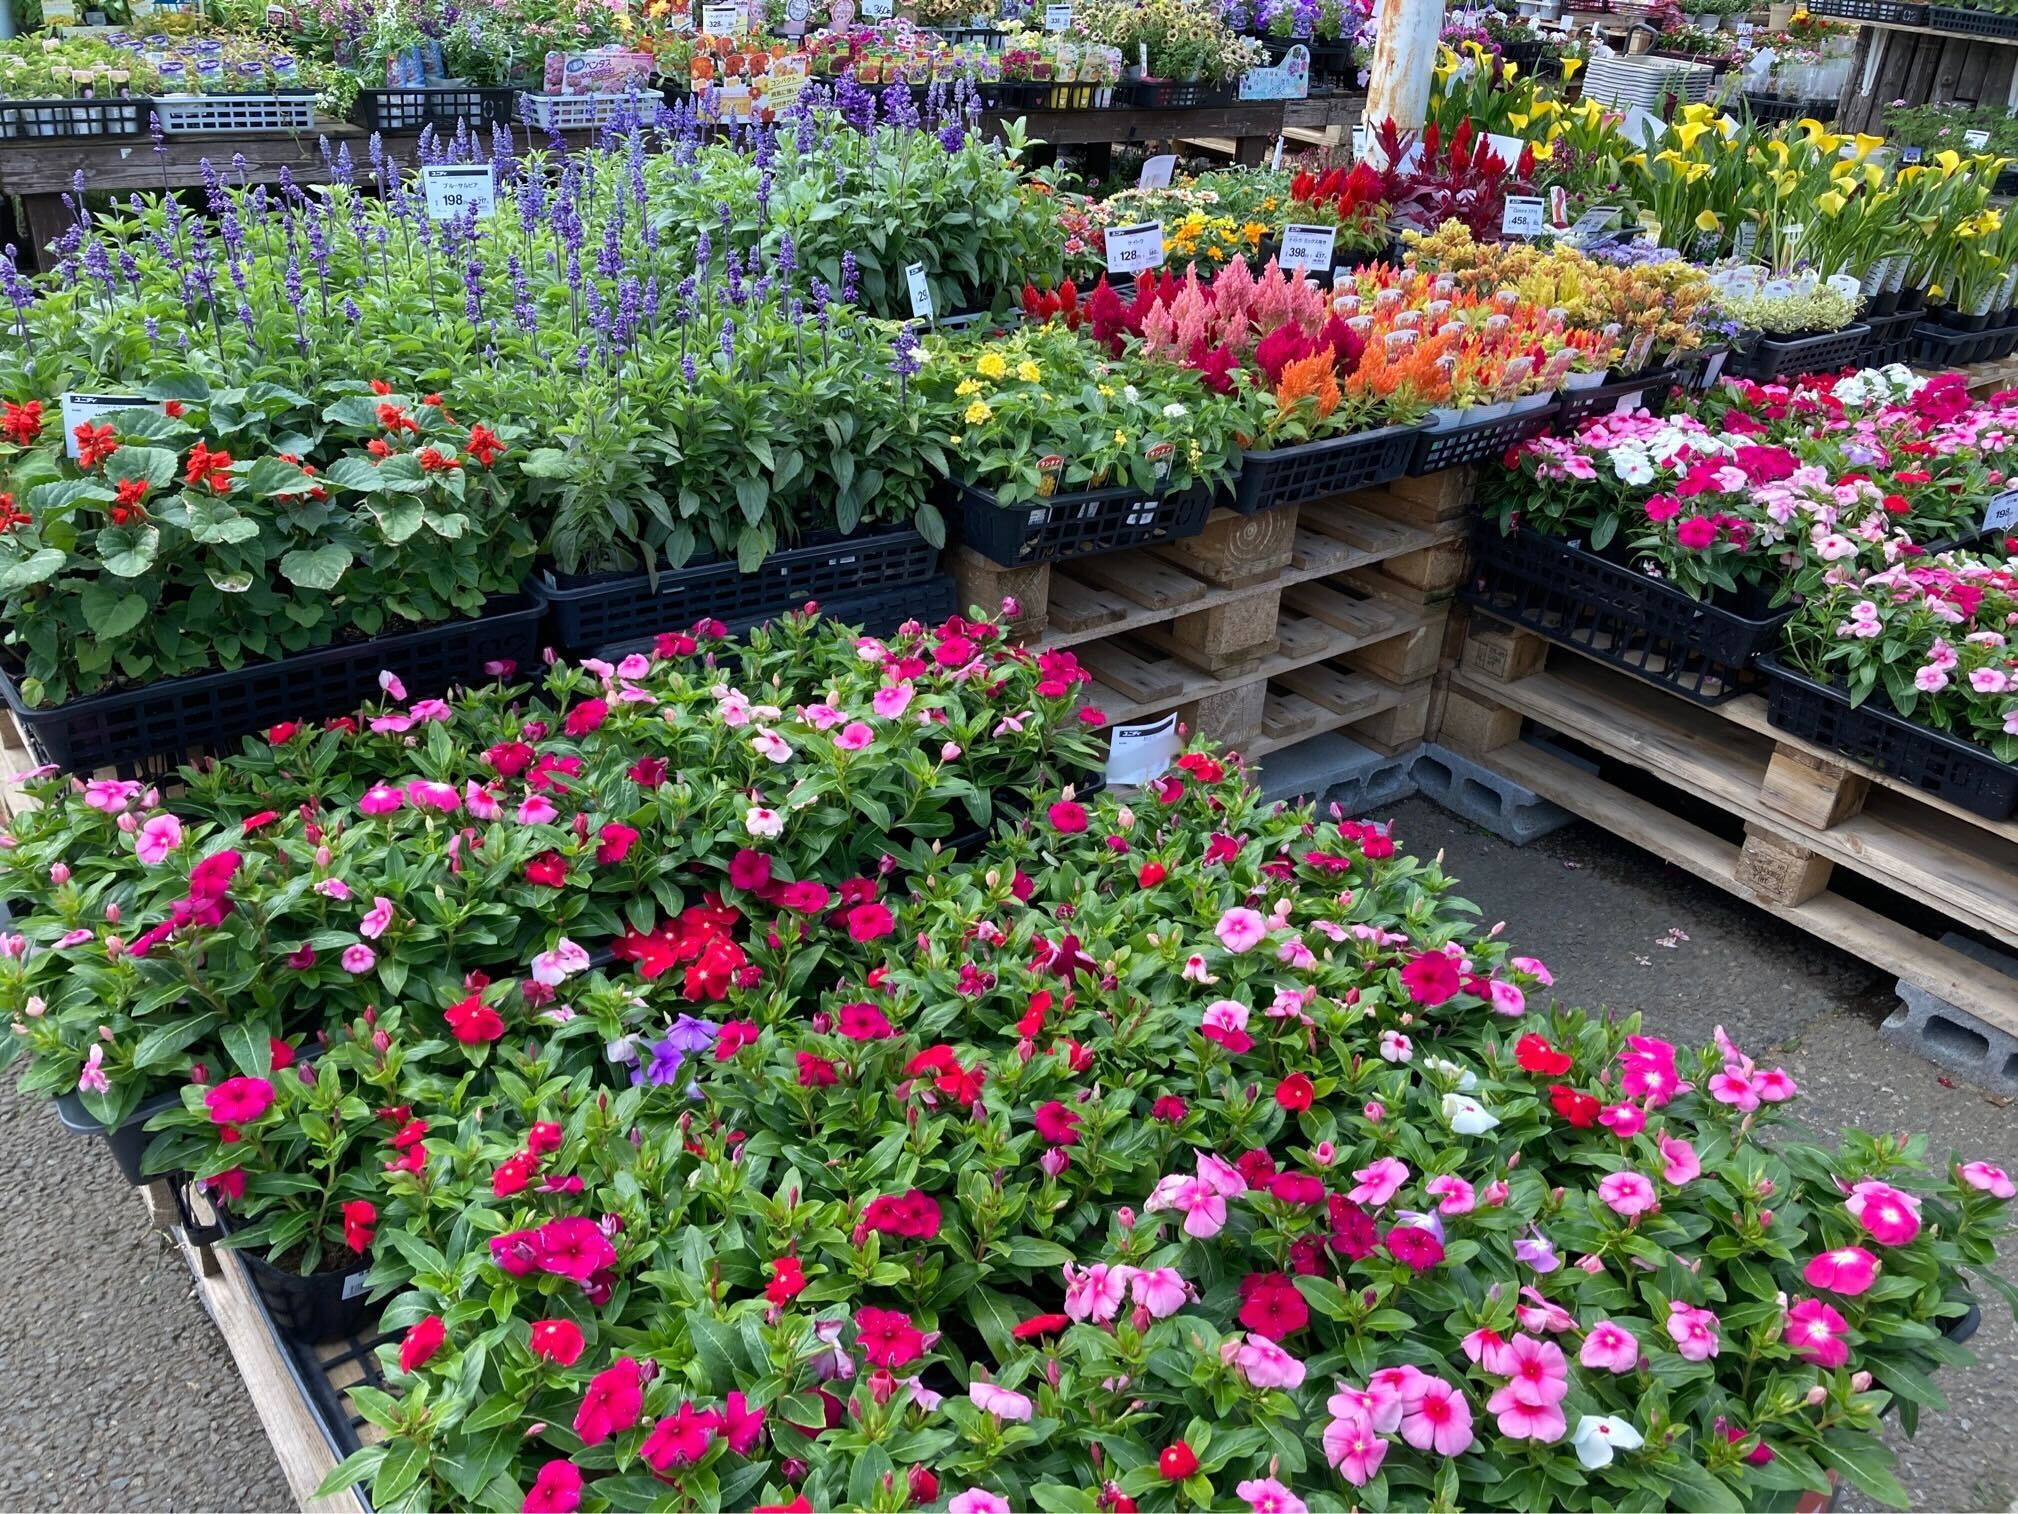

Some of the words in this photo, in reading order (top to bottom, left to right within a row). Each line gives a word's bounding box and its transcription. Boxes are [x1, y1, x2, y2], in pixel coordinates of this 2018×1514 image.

[585, 58, 612, 70] ペンタス
[771, 76, 797, 87] コンパクト
[442, 194, 463, 206] 198
[1511, 216, 1527, 225] 458
[1120, 250, 1137, 261] 128
[1289, 247, 1306, 258] 398
[1996, 507, 2011, 519] 198
